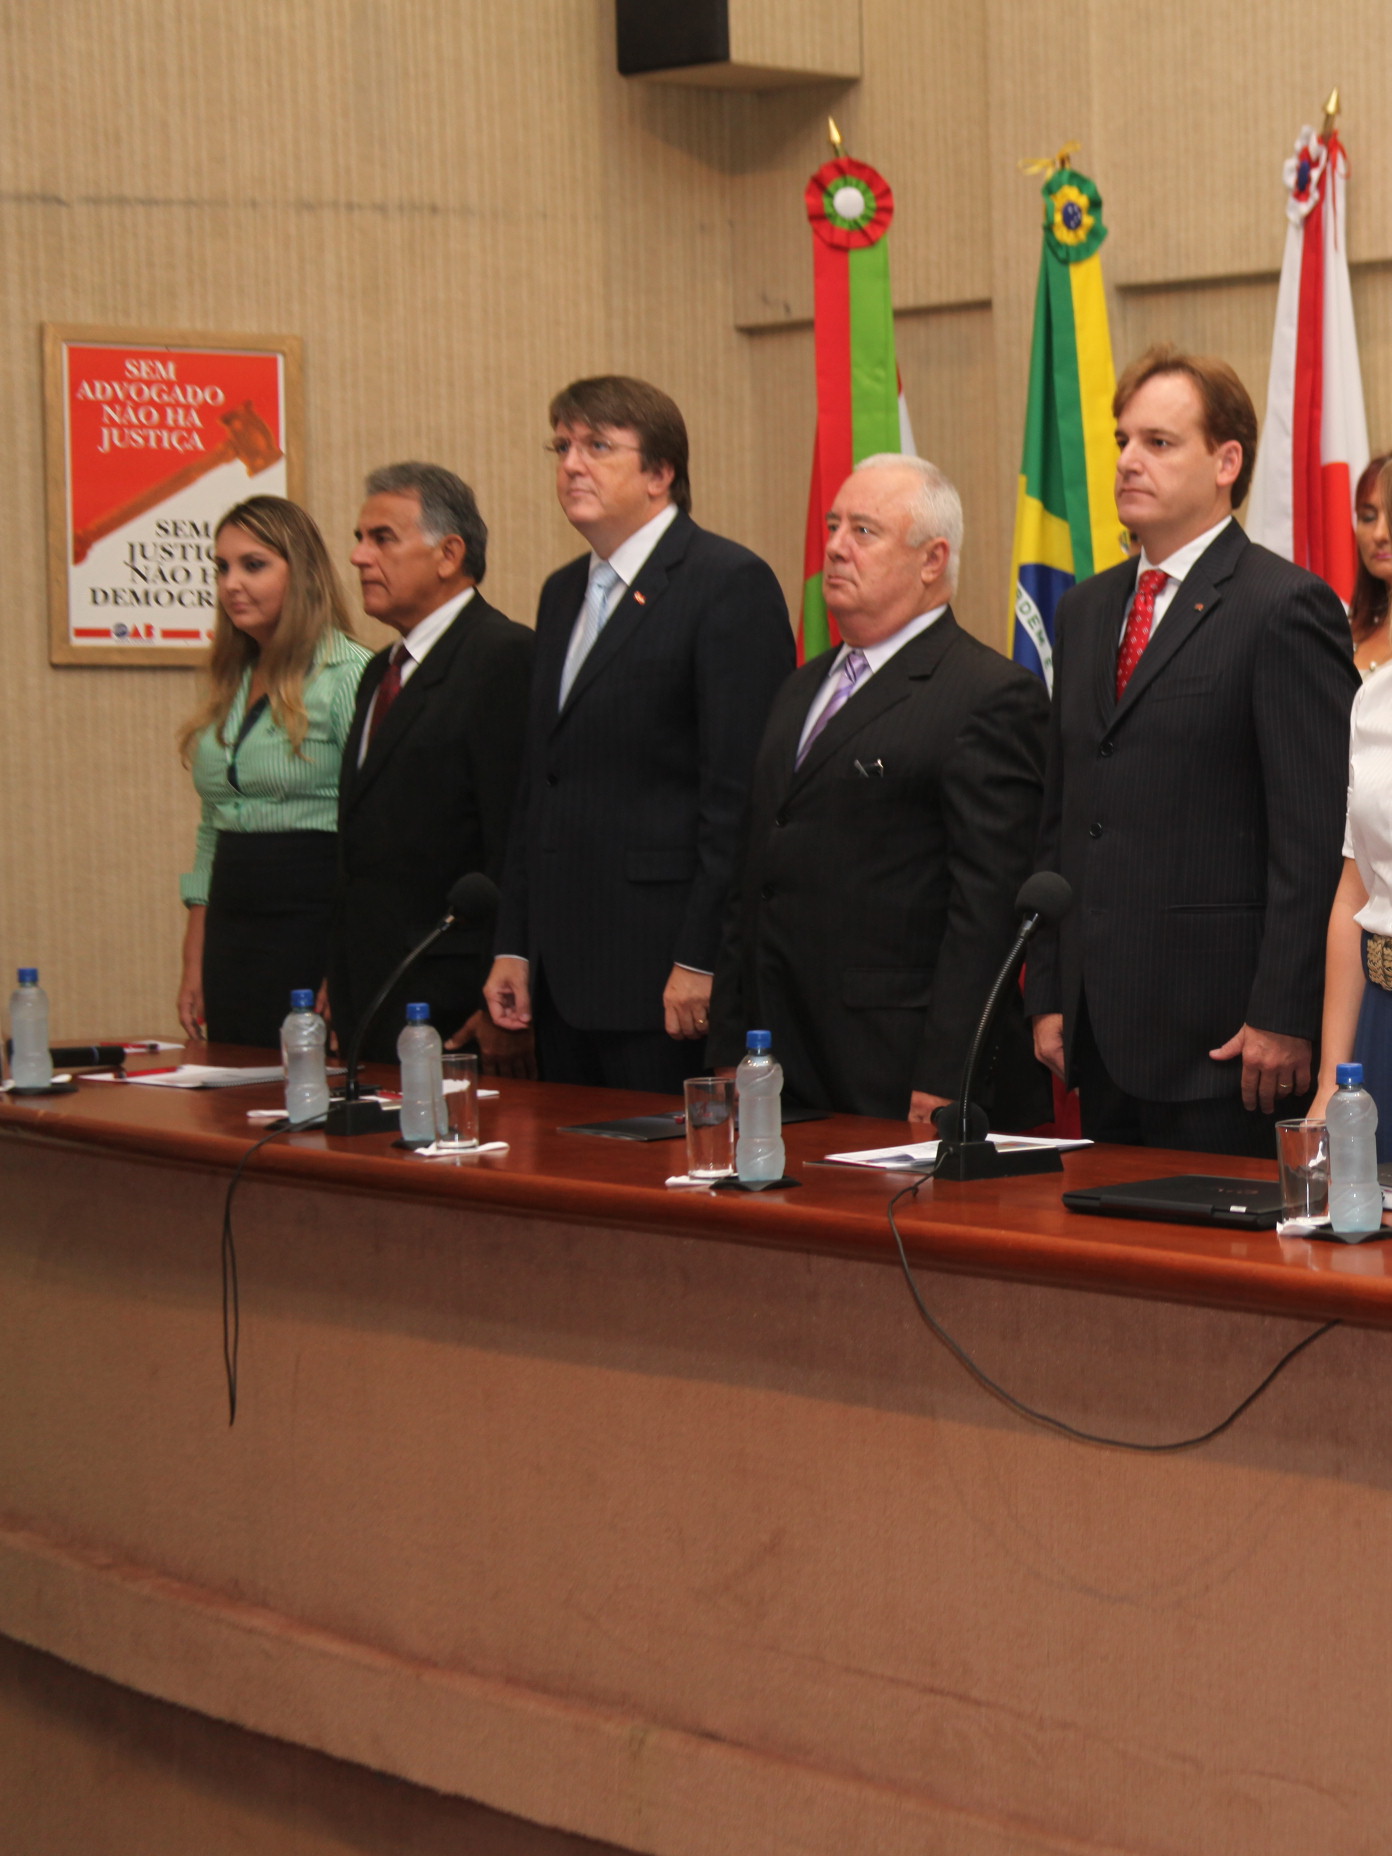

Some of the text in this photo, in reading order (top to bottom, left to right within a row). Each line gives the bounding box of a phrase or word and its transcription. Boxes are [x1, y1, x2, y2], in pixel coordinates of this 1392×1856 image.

[125, 358, 177, 381] SEM
[76, 379, 225, 406] ADVOGADO
[101, 401, 160, 426] NÃO
[97, 427, 205, 454] JUSTIÇA
[155, 520, 212, 538] SEM
[123, 542, 217, 567] JUSTI
[128, 562, 191, 584] NÃO
[89, 587, 216, 608] DEMOCR
